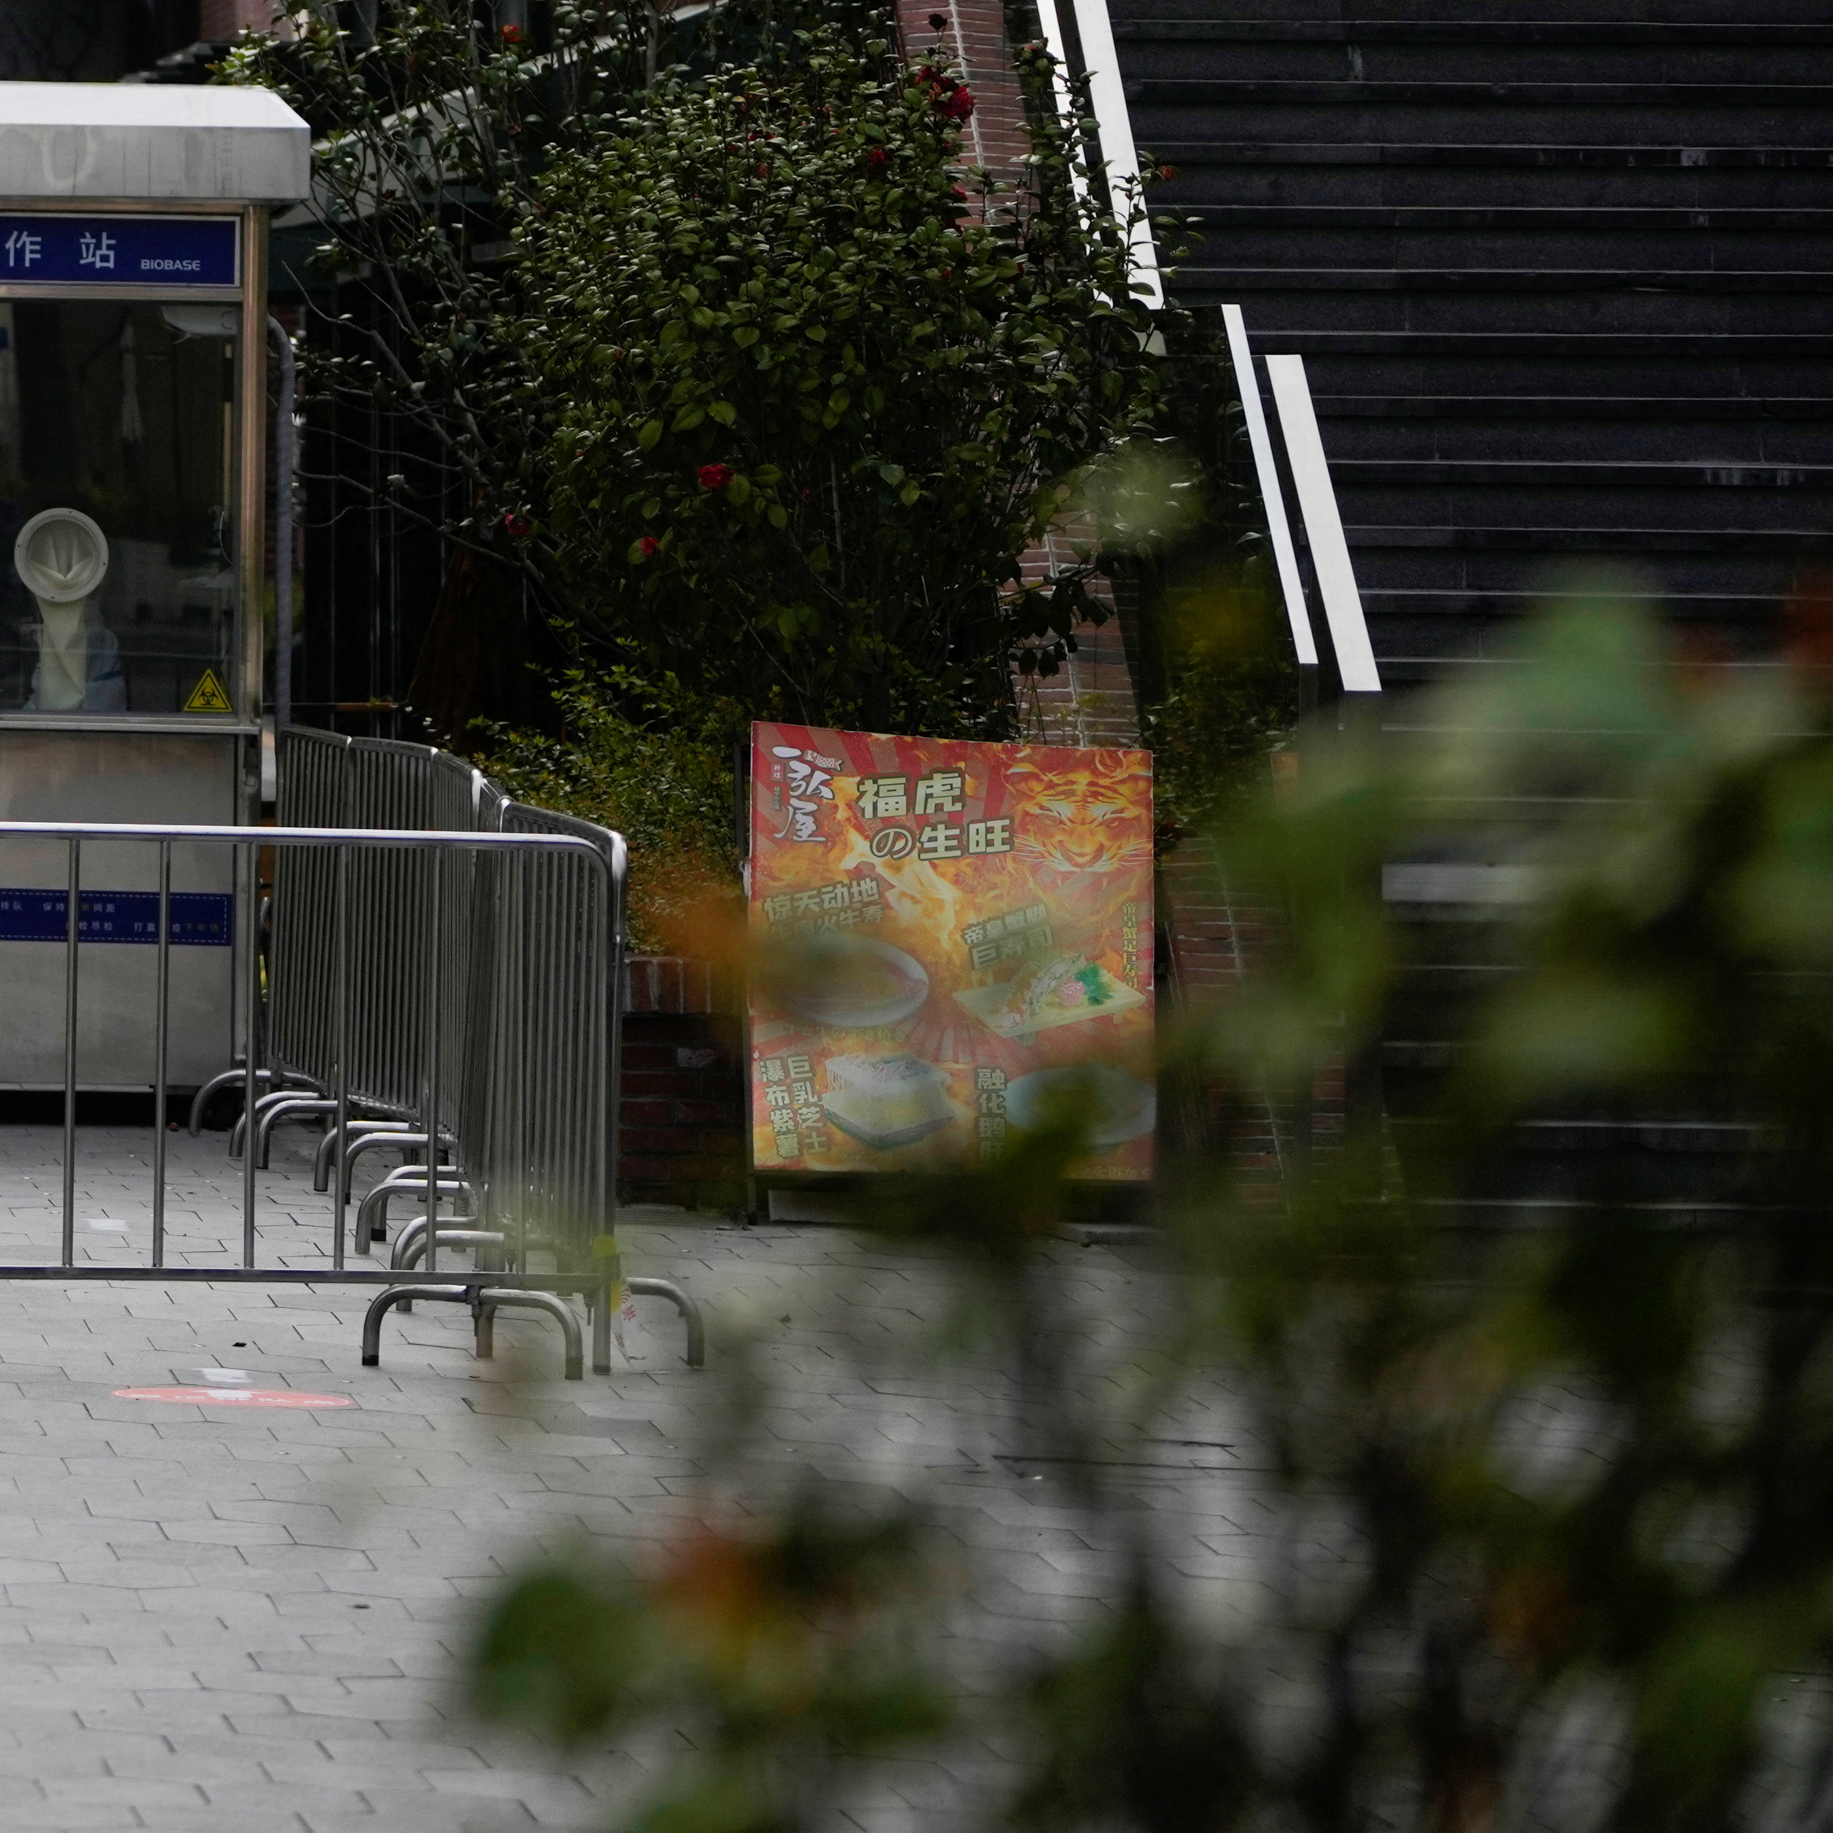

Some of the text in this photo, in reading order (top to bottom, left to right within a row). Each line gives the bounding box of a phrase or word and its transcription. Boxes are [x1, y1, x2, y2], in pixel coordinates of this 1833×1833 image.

[140, 259, 201, 270] BIOBASE
[857, 770, 967, 819] 福虎
[870, 818, 1014, 861] の生旺
[42, 900, 116, 914] 保持米间距
[763, 877, 880, 922] 惊天动地
[134, 921, 220, 933] 打赢疫下半场
[759, 1058, 801, 1158] 瀑布紫薯
[786, 1055, 830, 1155] 巨乳芝士
